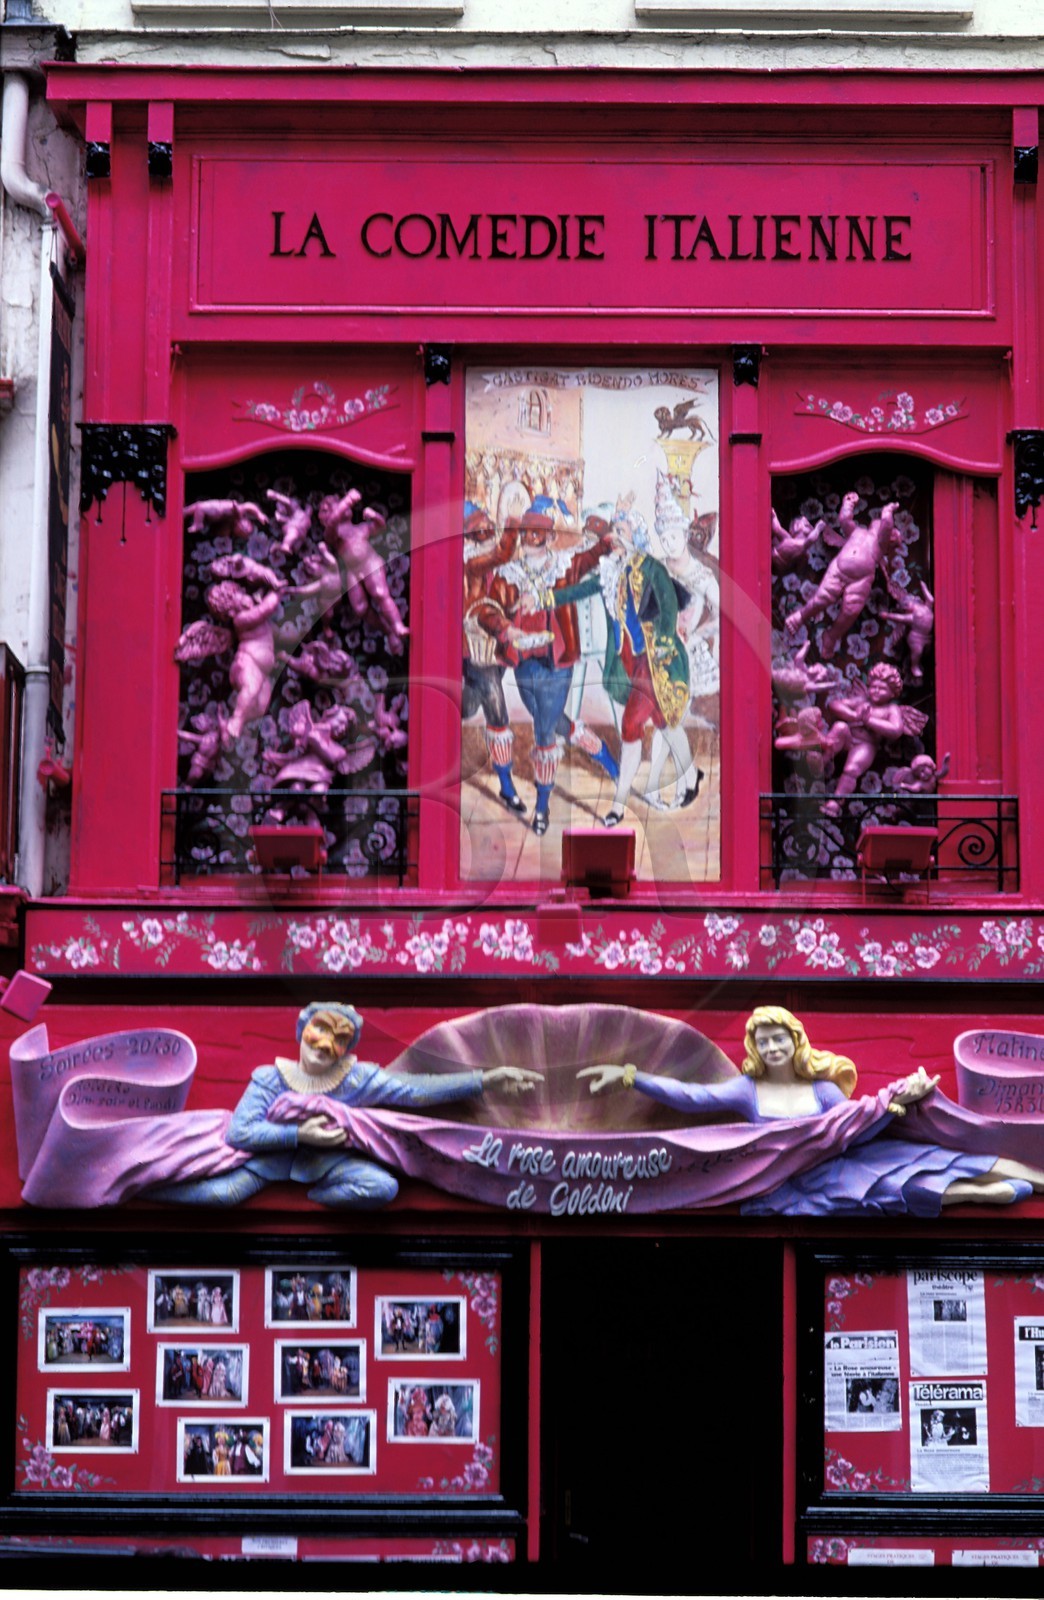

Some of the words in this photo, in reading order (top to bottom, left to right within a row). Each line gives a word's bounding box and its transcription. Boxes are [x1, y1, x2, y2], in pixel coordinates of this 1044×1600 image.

[270, 211, 337, 258] LA
[361, 212, 605, 260] COMEDIE
[644, 214, 912, 261] ITALIENNE
[576, 371, 643, 390] RIDENDO
[649, 371, 700, 390] MORES
[462, 1132, 503, 1168] La
[507, 1142, 556, 1174] rose
[561, 1147, 672, 1180] amoureuse
[506, 1180, 537, 1210] de
[550, 1181, 633, 1216] Goldoni
[914, 1268, 978, 1285] pariscope
[914, 1385, 983, 1399] Télérama
